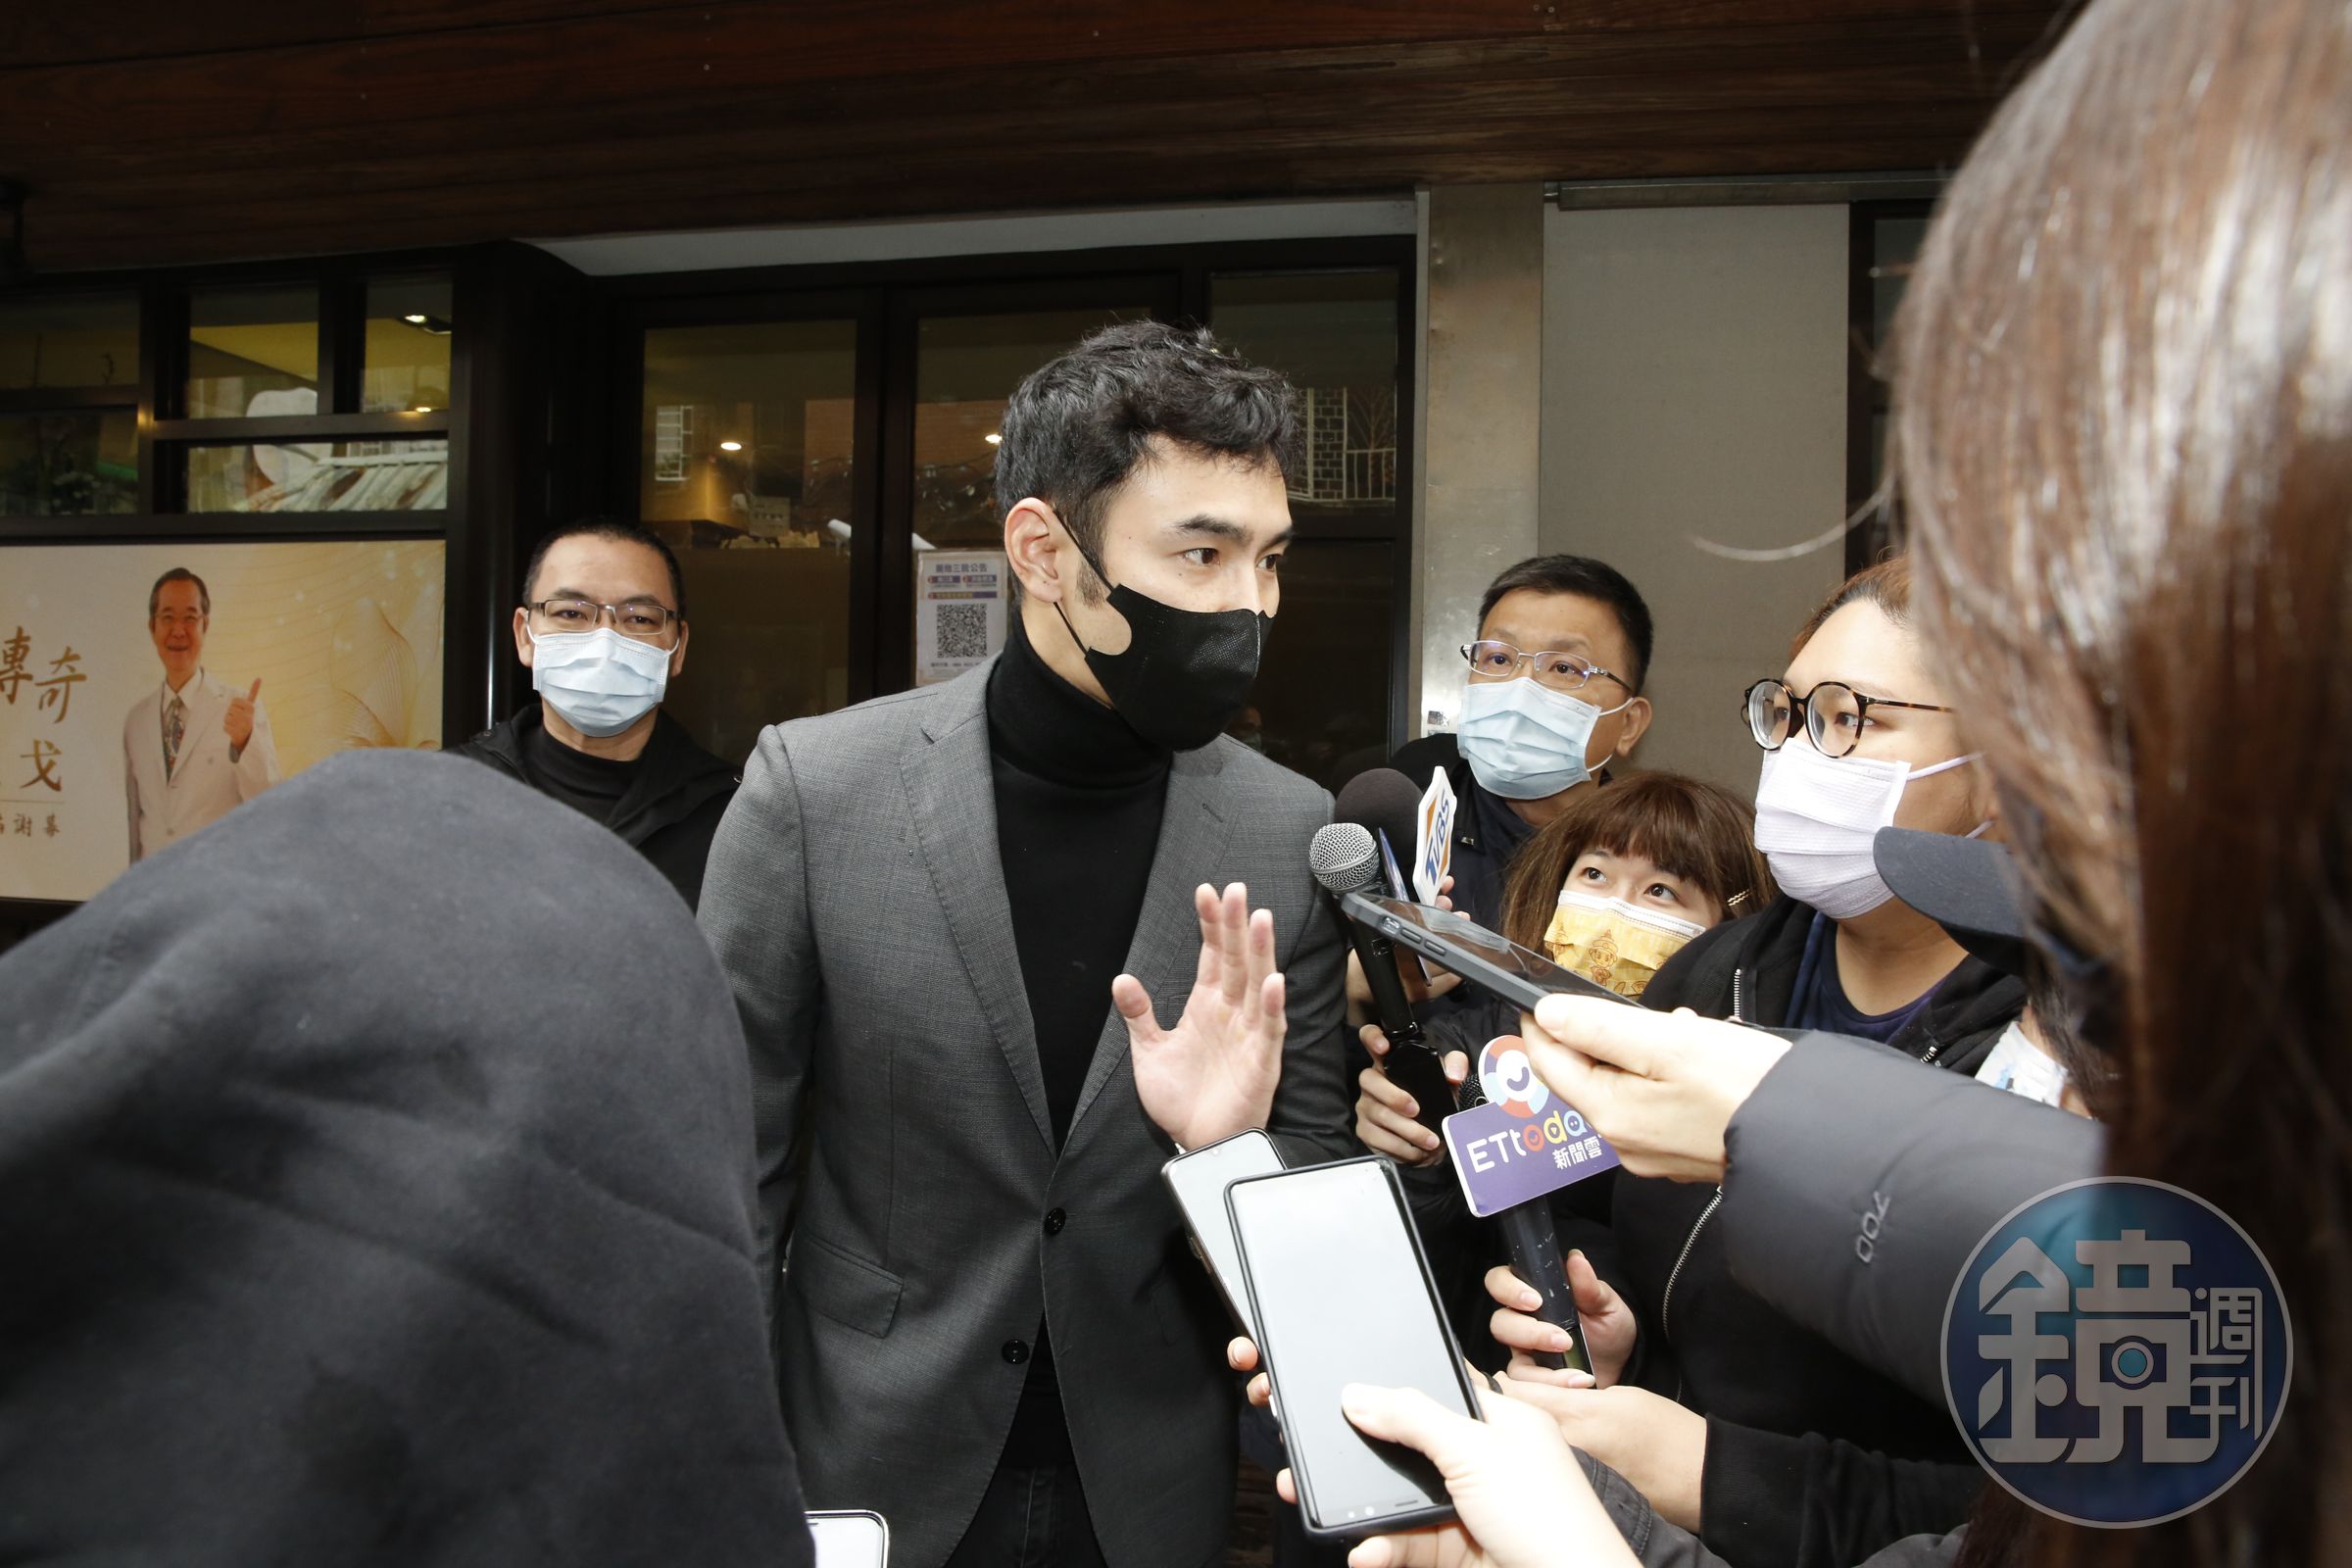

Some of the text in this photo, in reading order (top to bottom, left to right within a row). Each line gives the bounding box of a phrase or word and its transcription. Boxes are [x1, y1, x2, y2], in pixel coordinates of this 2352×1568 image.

[1425, 789, 1449, 886] TVBS
[1466, 1109, 1603, 1173] ETtoda
[1551, 1135, 1602, 1170] 新聞雲
